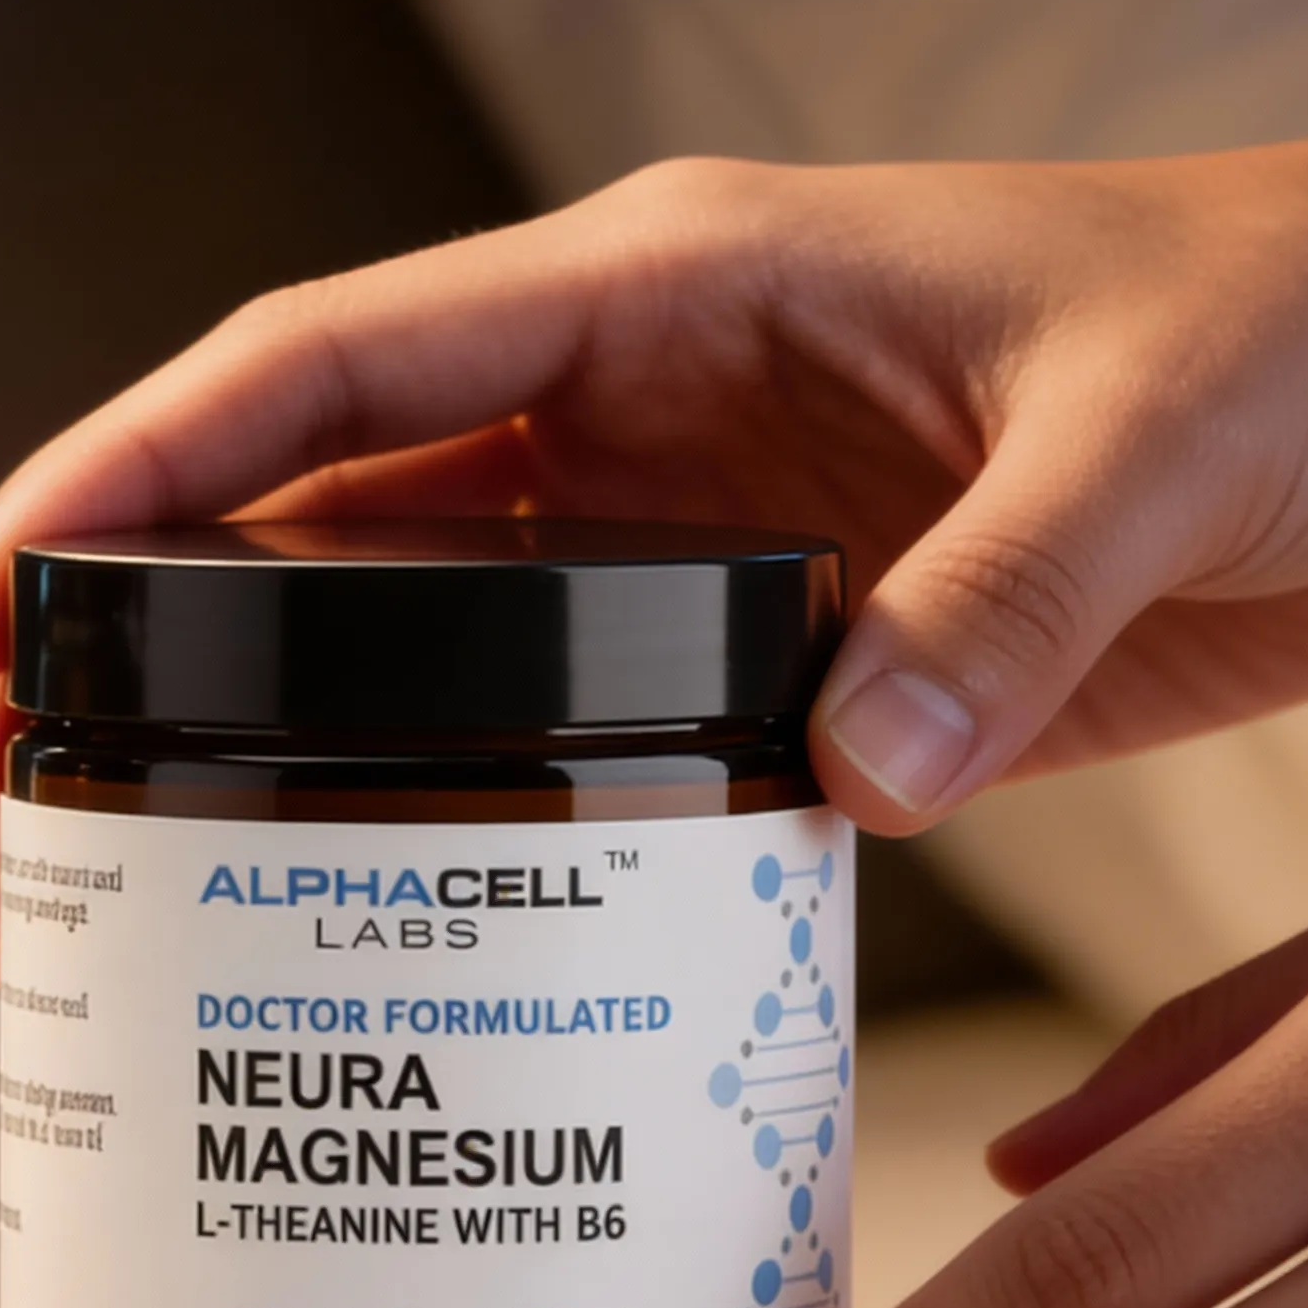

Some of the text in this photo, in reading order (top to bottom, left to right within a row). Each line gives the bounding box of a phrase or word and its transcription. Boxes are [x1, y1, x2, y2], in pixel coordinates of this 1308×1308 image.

[199, 864, 604, 909] ALPHACELL
[315, 917, 480, 950] LABS
[197, 993, 672, 1036] DOCTOR FORMULATED
[197, 1047, 442, 1112] NEURA
[197, 1123, 624, 1188] MAGNESIUM
[196, 1200, 627, 1245] L-THEANINE WITH B6
